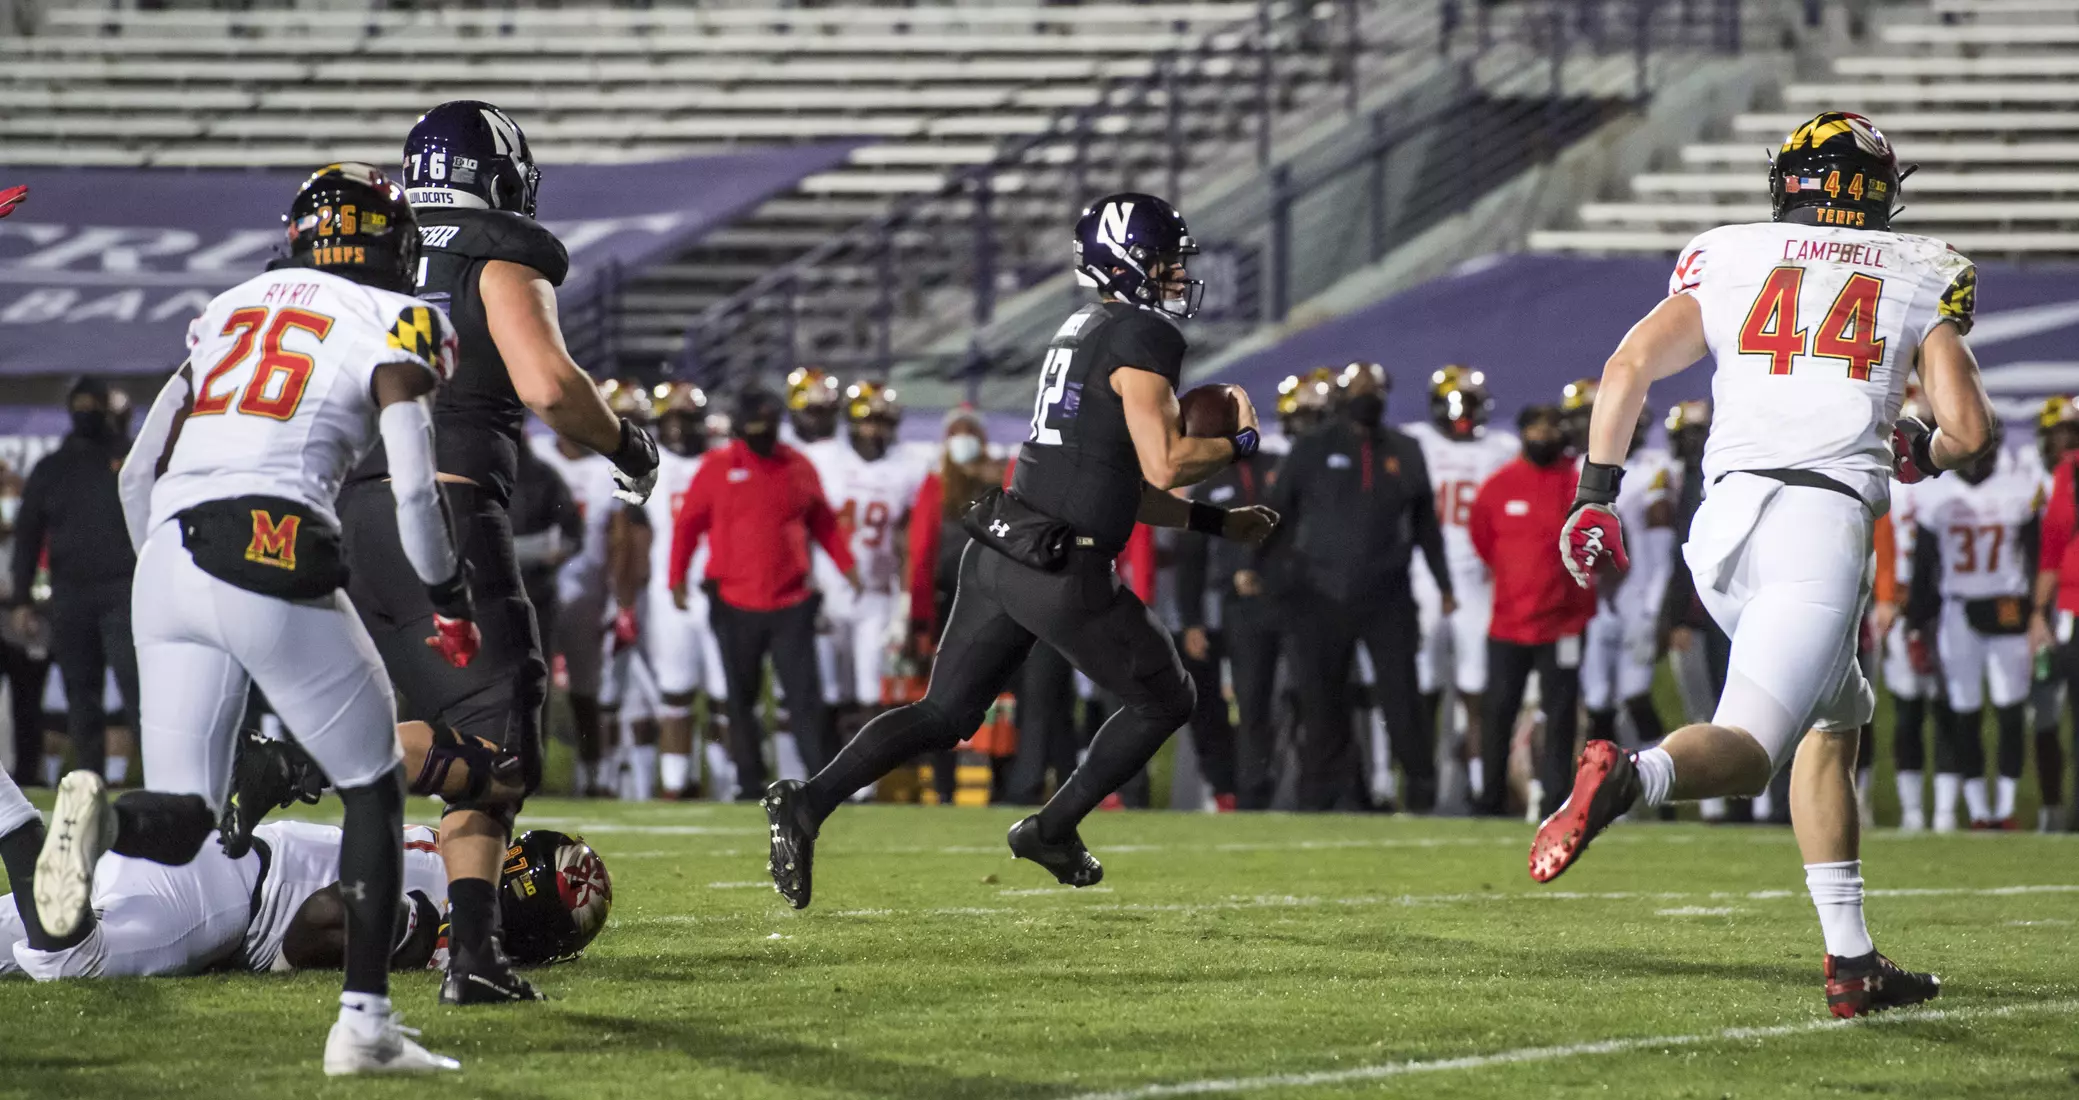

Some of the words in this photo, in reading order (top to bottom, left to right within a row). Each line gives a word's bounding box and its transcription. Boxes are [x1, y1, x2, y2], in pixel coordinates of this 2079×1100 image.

[411, 153, 446, 181] 76
[409, 192, 454, 204] WILDCATS
[1824, 171, 1863, 200] 44
[318, 204, 356, 236] 26
[1097, 202, 1134, 243] N
[1817, 208, 1865, 226] TERPS
[313, 246, 365, 265] TERPS
[1784, 239, 1884, 268] CAMPBELL
[1738, 266, 1886, 382] 44
[189, 306, 336, 421] 26
[1030, 348, 1073, 445] 12
[244, 509, 301, 570] M
[1949, 523, 2004, 573] 37
